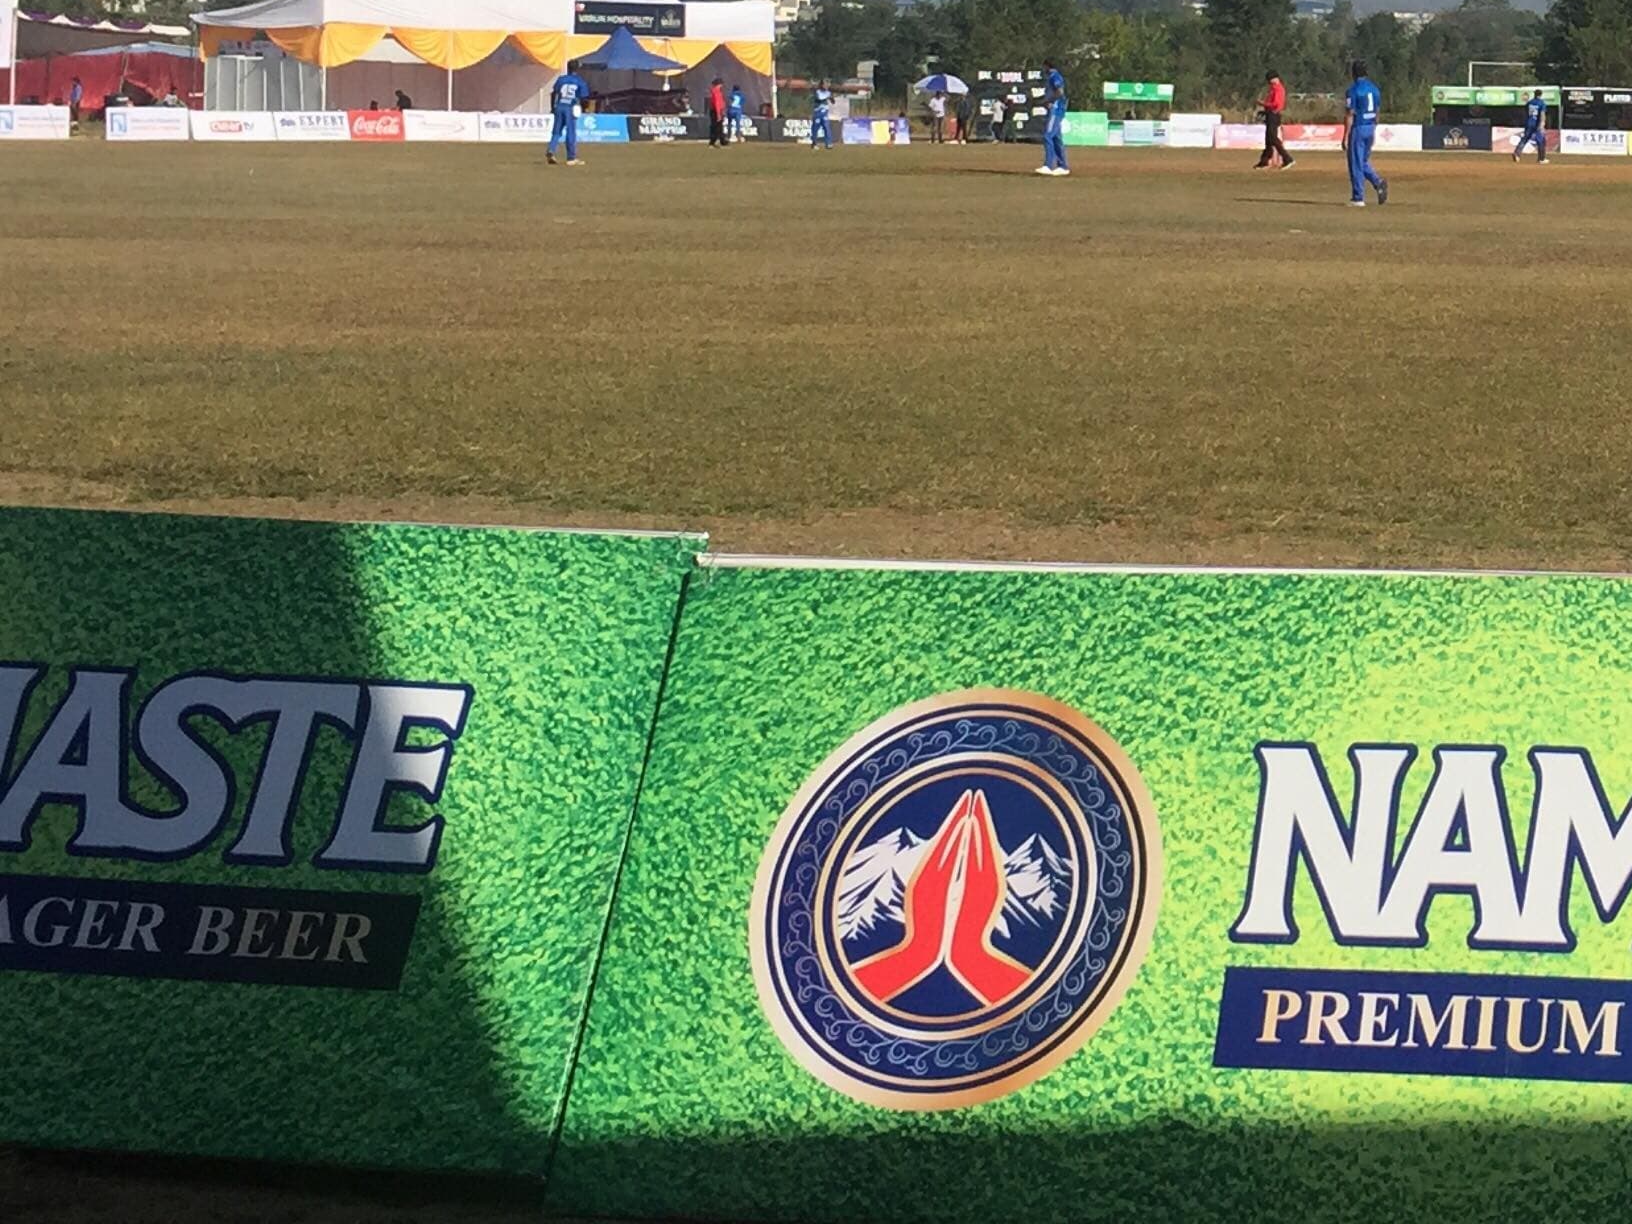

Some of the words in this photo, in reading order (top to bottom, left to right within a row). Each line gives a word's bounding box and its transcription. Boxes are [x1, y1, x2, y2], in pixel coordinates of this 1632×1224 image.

[299, 115, 345, 127] EXPERT
[504, 118, 552, 129] EXPERT
[640, 116, 682, 127] GRAND
[638, 125, 688, 135] MASTER
[1583, 133, 1625, 143] EXPERT
[188, 905, 373, 964] BEER
[1254, 986, 1625, 1058] PREMIUM
